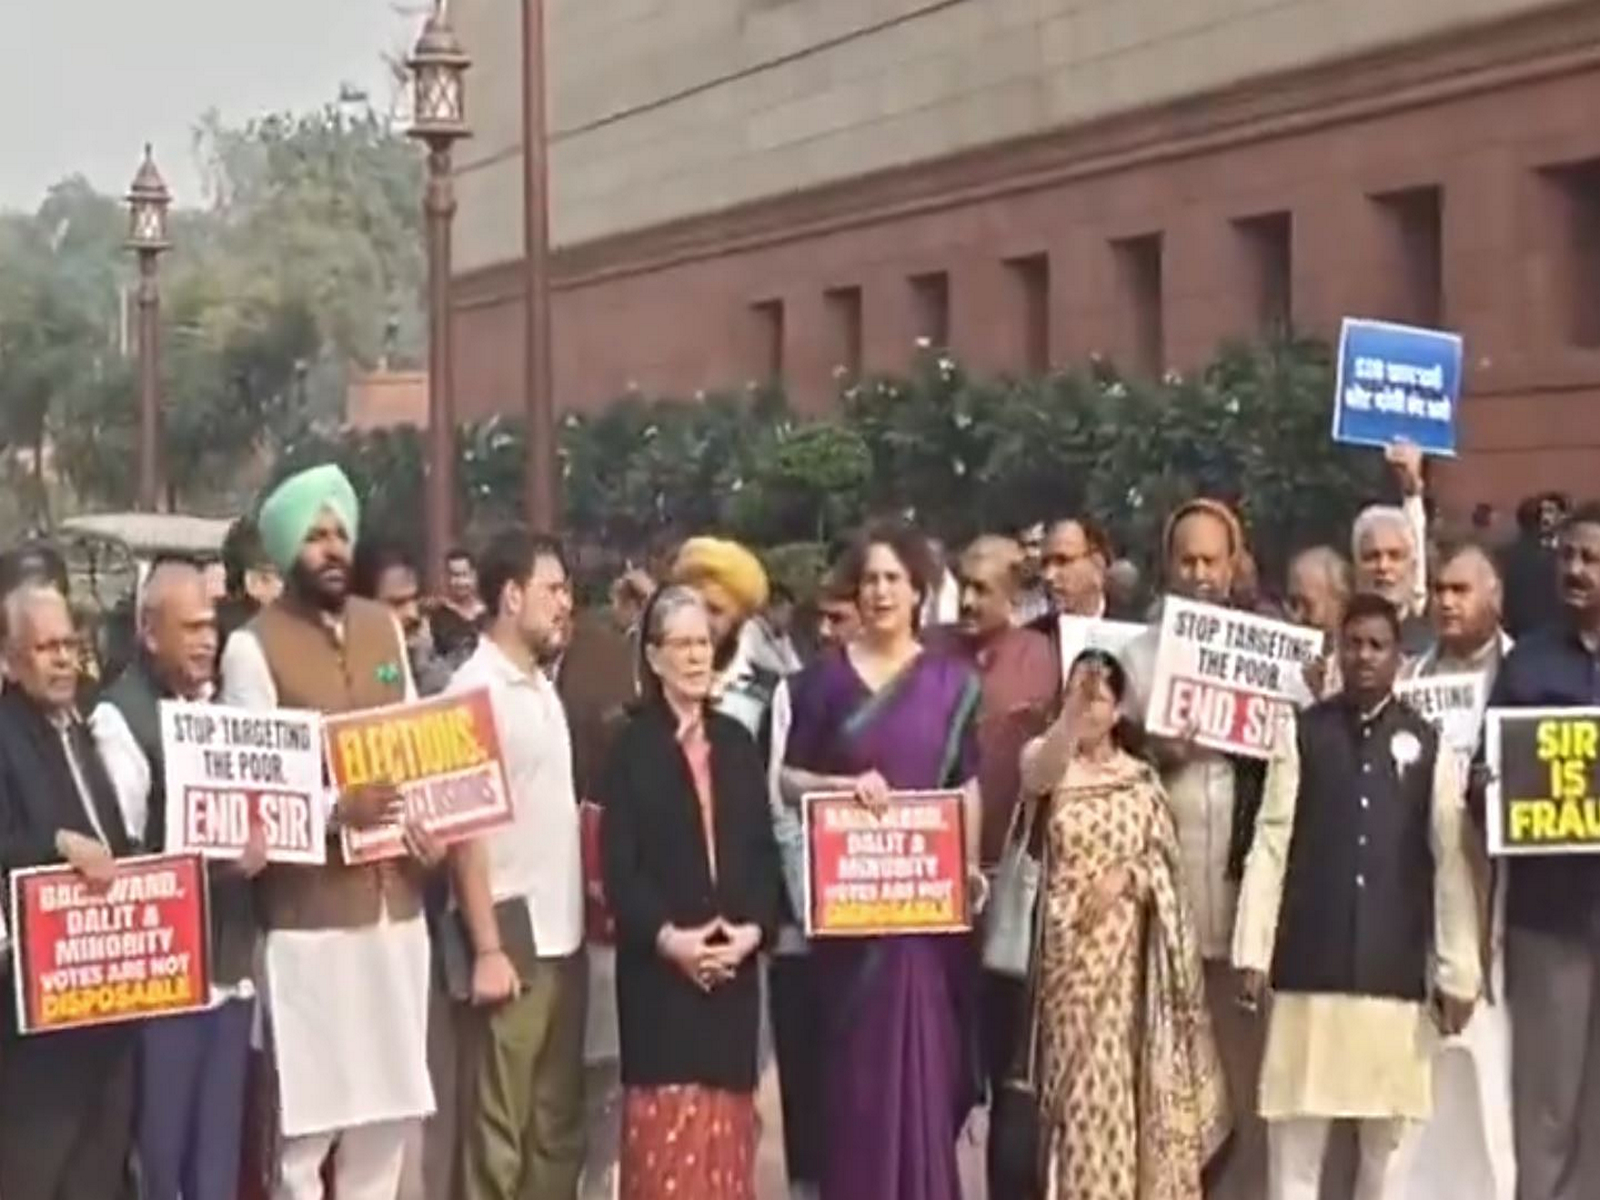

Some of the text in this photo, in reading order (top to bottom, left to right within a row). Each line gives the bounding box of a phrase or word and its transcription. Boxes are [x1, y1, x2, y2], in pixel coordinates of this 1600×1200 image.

[1175, 610, 1220, 642] STOP
[1199, 648, 1229, 679] THE
[174, 713, 311, 750] STOP TARGETING
[1169, 681, 1274, 749] END SI
[1537, 721, 1598, 759] SIR
[203, 750, 233, 780] THE
[1551, 759, 1586, 798] IS
[188, 790, 309, 848] END SIR
[66, 906, 135, 935] DALIT
[54, 927, 174, 966] MINORITY
[40, 953, 190, 991] VOTES ARE NOT
